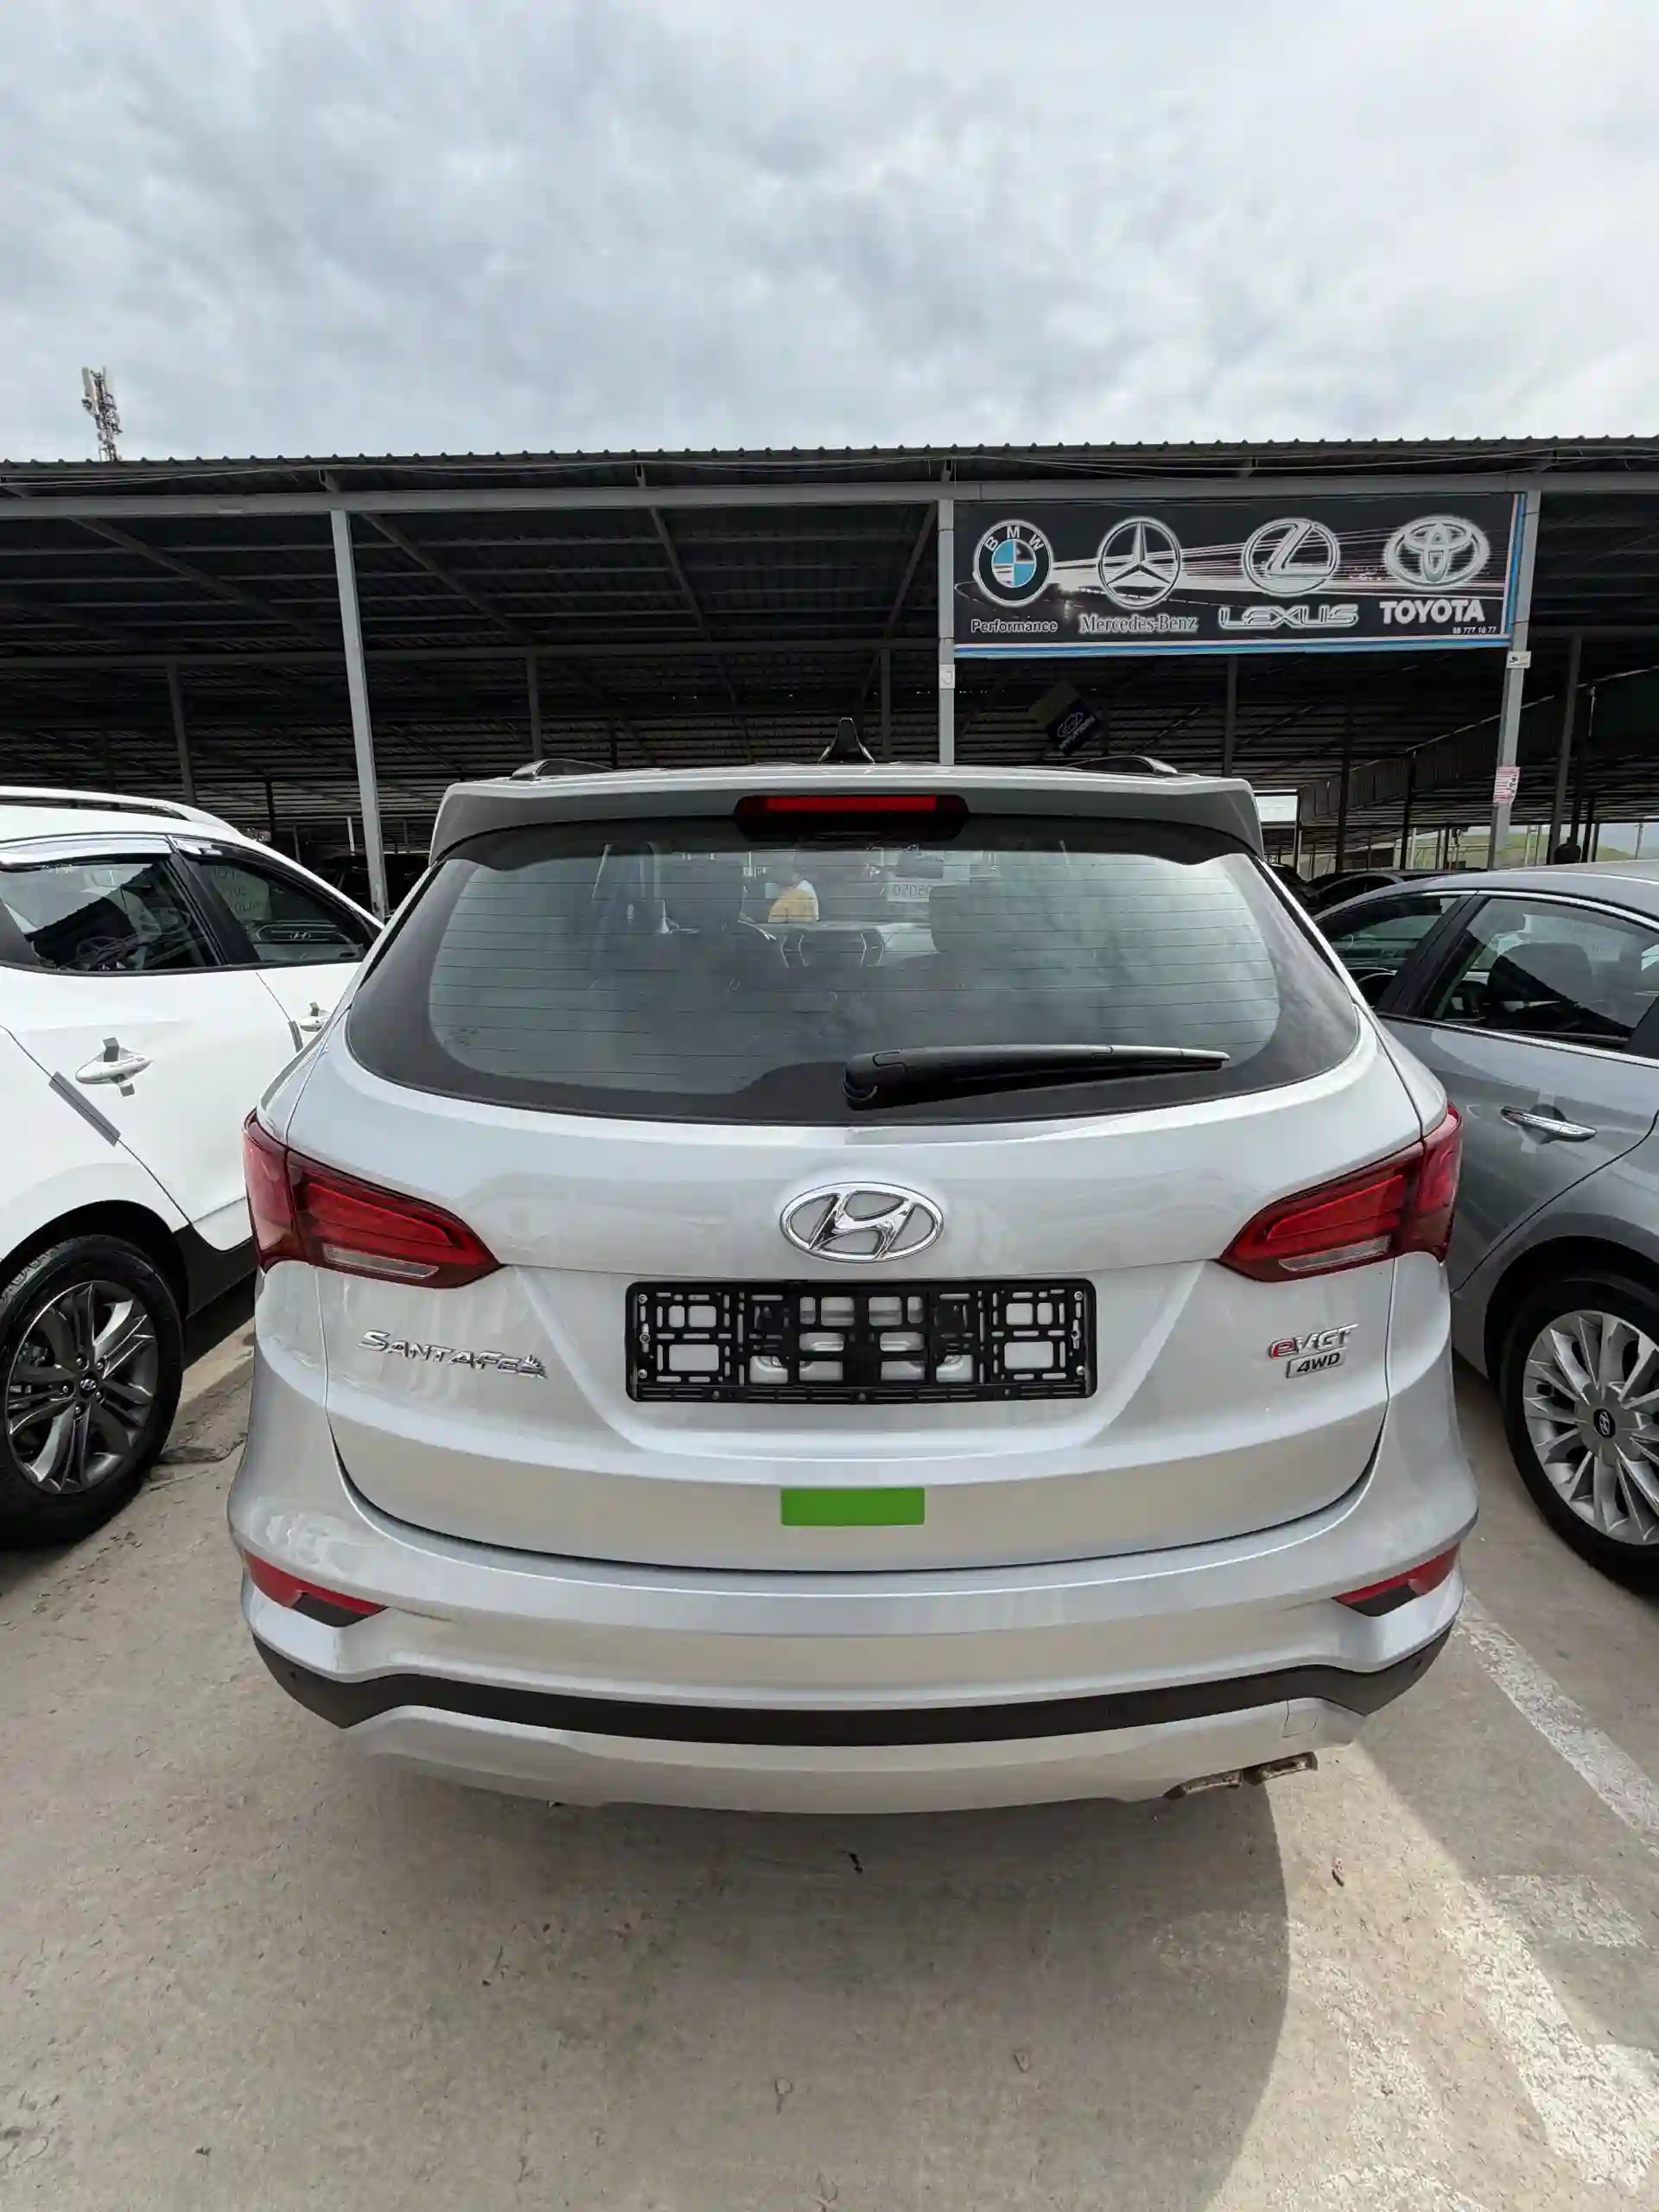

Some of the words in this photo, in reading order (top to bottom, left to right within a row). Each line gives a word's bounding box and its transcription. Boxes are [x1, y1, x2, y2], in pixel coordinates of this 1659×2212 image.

[984, 525, 1044, 552] BMW
[1079, 613, 1198, 633] Mercedes-Benz
[1217, 605, 1359, 631] LEXUS
[1379, 599, 1485, 625] TOYOTA
[971, 619, 1058, 633] Performance
[1268, 1323, 1358, 1359] eVGT
[1296, 1351, 1341, 1373] 4WD
